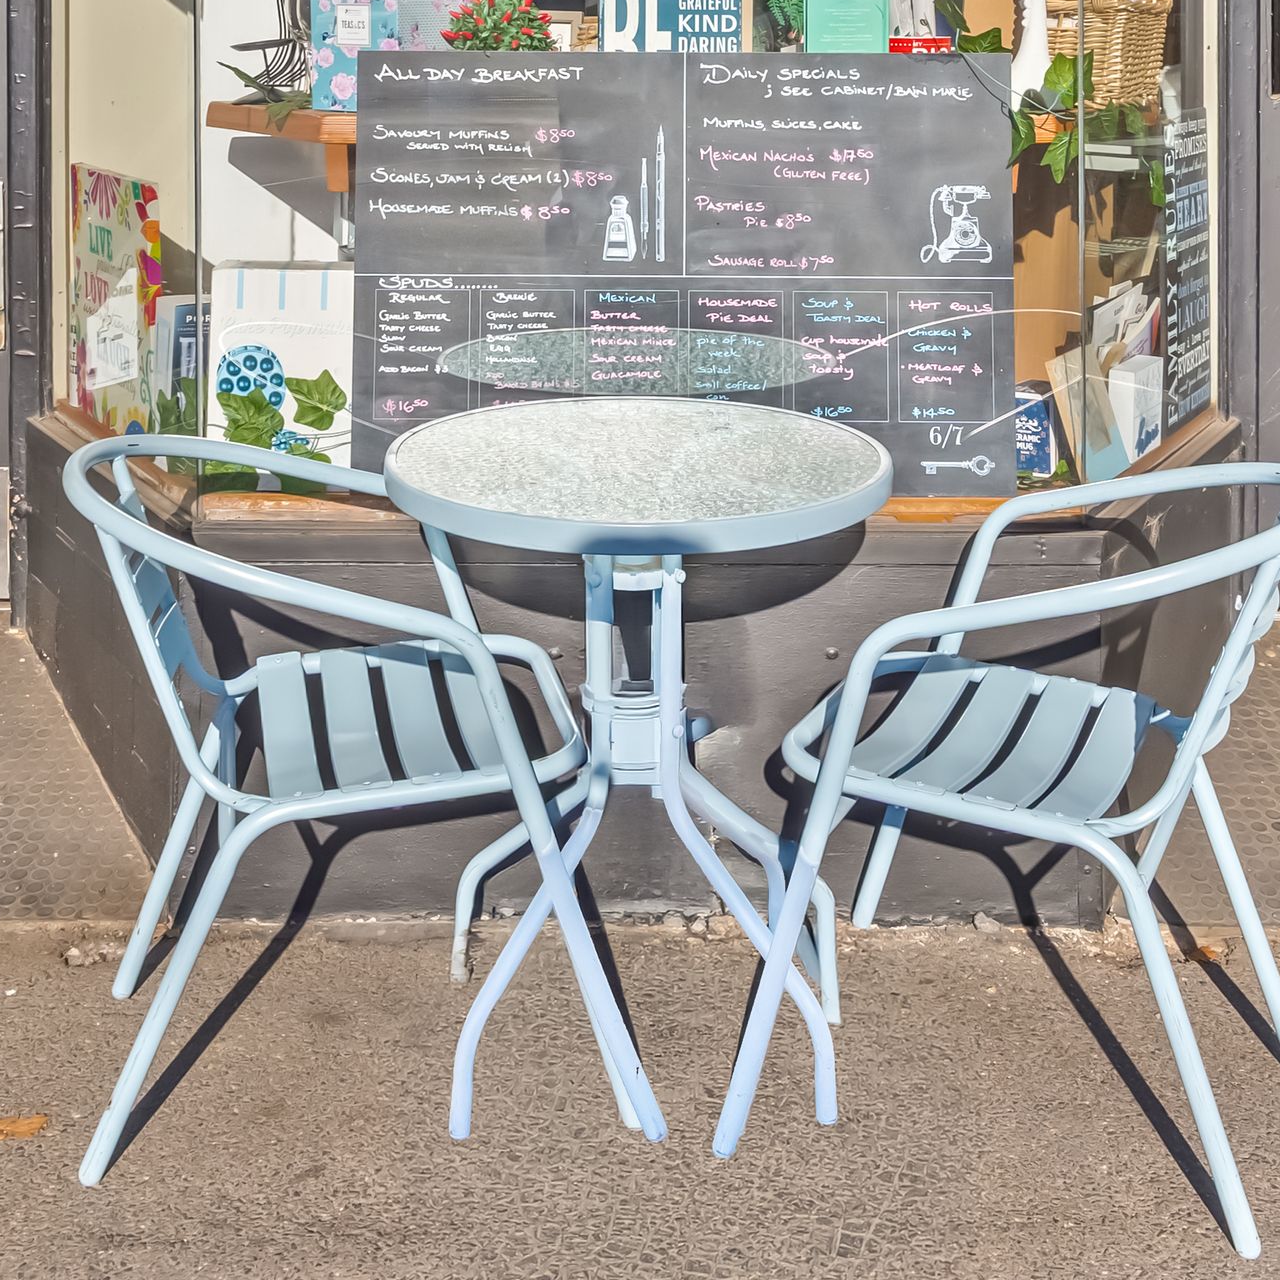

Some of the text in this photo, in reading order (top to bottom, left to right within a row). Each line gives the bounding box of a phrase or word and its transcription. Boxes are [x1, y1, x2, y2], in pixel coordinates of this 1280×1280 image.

[678, 14, 738, 33] KIND
[678, 36, 738, 53] DARING
[374, 63, 584, 84] ALL DAY BREAKFAST
[699, 63, 861, 84] DAILY SPECIALS
[780, 85, 973, 101] SEE MARIE
[372, 124, 510, 141] SAVOURY MUFFINS
[406, 141, 450, 152] SERVED
[454, 141, 485, 155] WITH
[1174, 133, 1207, 160] PROMISES
[699, 145, 757, 171] MEXICAN
[435, 174, 470, 185] JAM
[490, 171, 542, 192] CREAM
[369, 198, 519, 220] HOUSEMADE MUFFINS
[694, 195, 765, 213] PASTRIES
[88, 222, 113, 262] LIVE
[707, 254, 798, 269] SAUSAGE ROLL
[84, 270, 110, 305] LOVE
[388, 292, 451, 304] REGULAR
[599, 292, 657, 304] MEXICAN
[697, 297, 778, 308] HOUSEMADE
[908, 299, 993, 313] HOT ROLLS
[412, 310, 451, 322] BUTTER
[522, 311, 557, 319] BUTTER
[590, 310, 641, 321] BUTTER
[737, 314, 774, 323] DEAL
[805, 313, 886, 324] TOASTY DEAL
[1178, 293, 1210, 334] LAUGH
[907, 327, 957, 337] CHICKEN
[590, 335, 677, 347] MEXICAN MINCE
[722, 334, 737, 346] of
[912, 342, 957, 356] GRAVY
[1167, 277, 1178, 428] FAMILY
[623, 354, 662, 364] CREAM
[1177, 339, 1210, 379] EVERYDAY
[591, 370, 662, 381] GUACAMOLE
[907, 363, 966, 374] MEATLOAF
[911, 375, 953, 386] GRAVY
[929, 423, 964, 449] 6/7
[1015, 433, 1041, 444] ERAMIC
[1015, 441, 1034, 451] MUG
